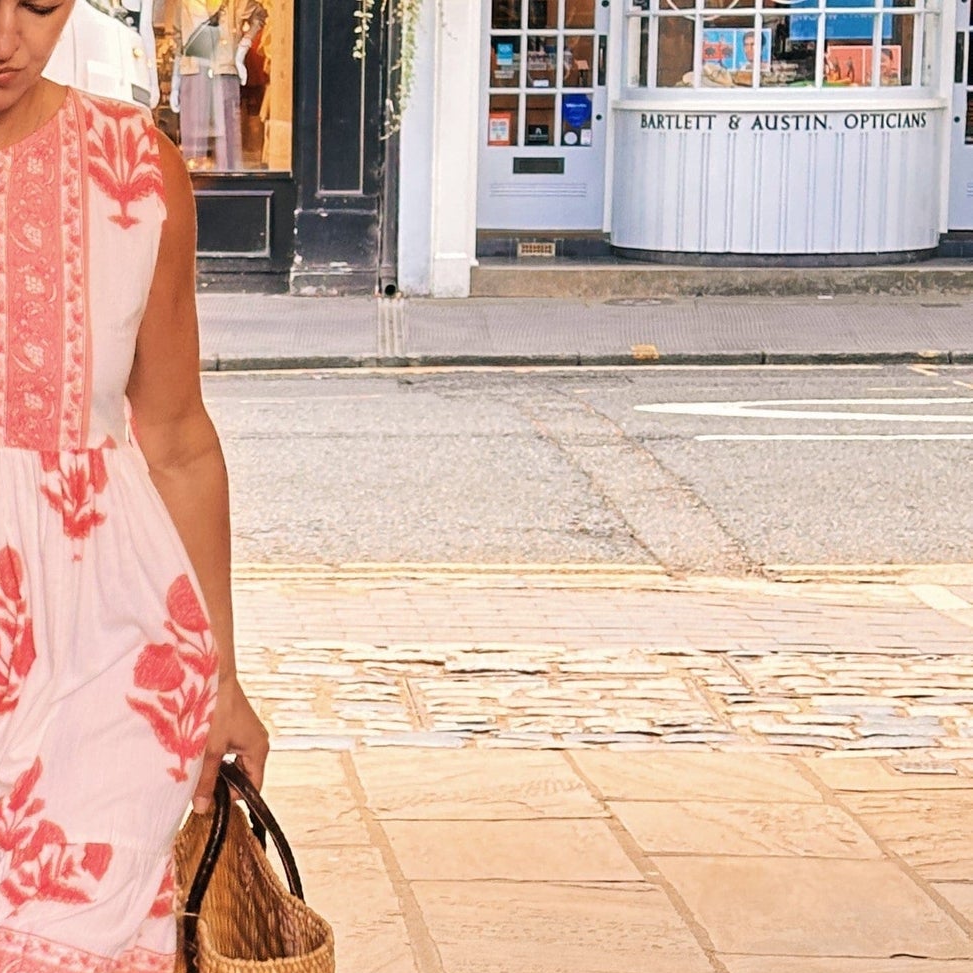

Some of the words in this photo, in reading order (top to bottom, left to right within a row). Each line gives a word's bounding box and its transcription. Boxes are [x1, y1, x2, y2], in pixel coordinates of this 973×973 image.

[640, 113, 716, 130] BARTLETT
[728, 114, 741, 130] &
[844, 112, 927, 130] OPTICIANS
